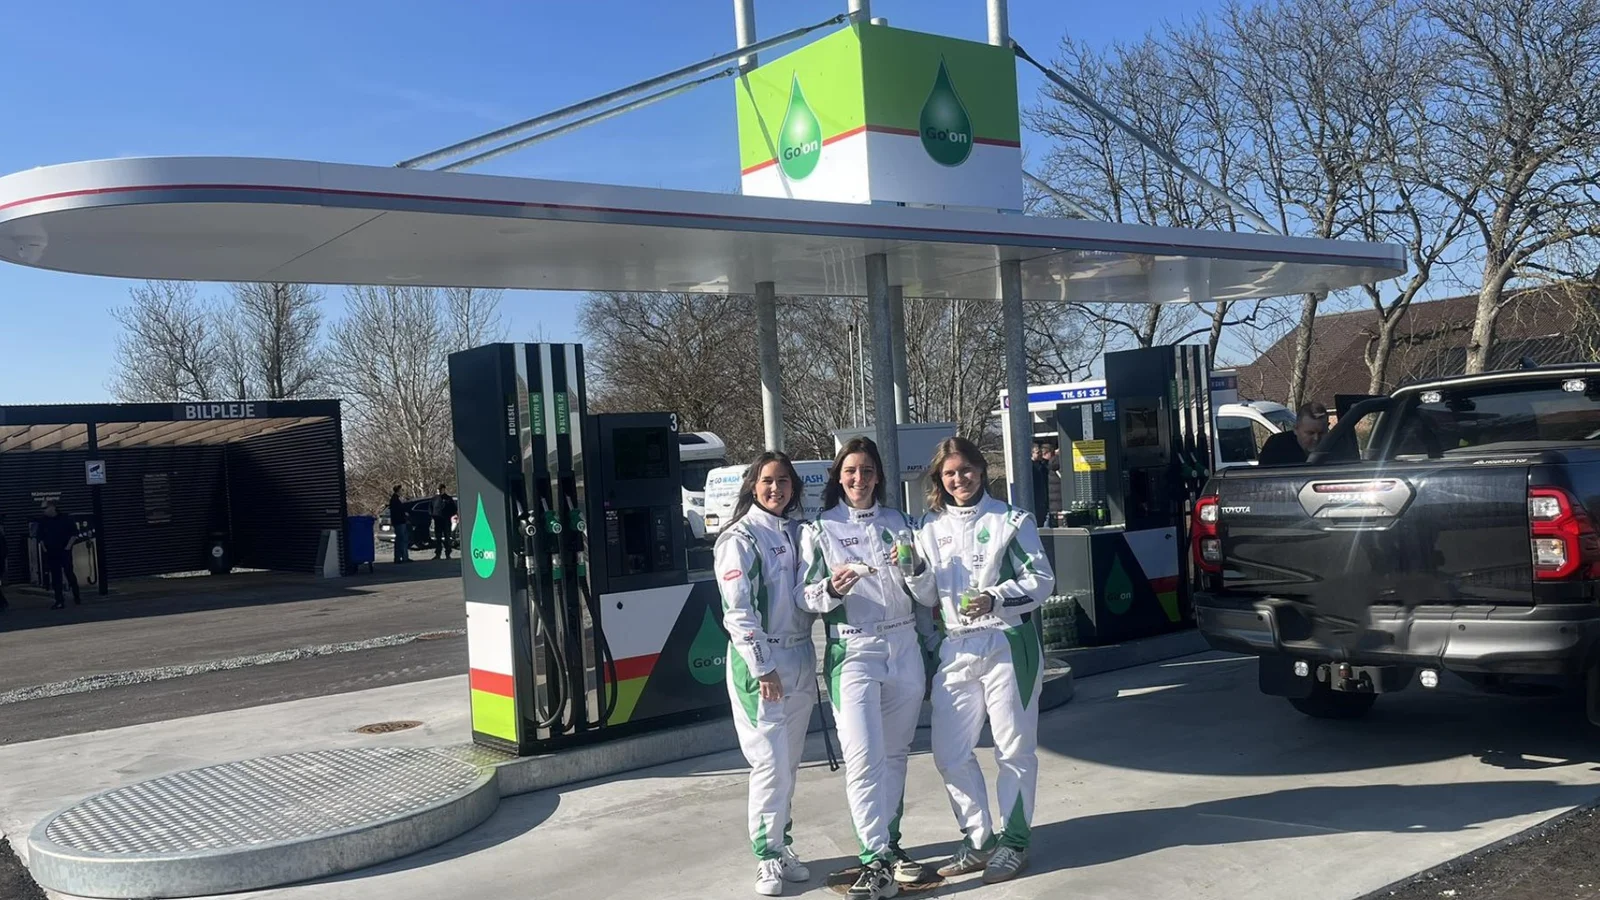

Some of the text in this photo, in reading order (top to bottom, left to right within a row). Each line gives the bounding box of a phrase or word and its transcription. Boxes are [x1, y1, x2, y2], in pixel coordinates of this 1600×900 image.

[926, 126, 968, 144] Go'on
[783, 138, 818, 160] Go'on
[1061, 391, 1075, 399] Tlf.
[1077, 390, 1087, 398] 51
[1089, 389, 1100, 397] 32
[185, 404, 256, 419] BILPLEJE
[507, 403, 516, 428] DIESEL
[669, 413, 678, 432] 3
[858, 511, 875, 519] HRX
[1221, 506, 1251, 514] TOYOTA
[839, 537, 859, 548] TSG
[938, 536, 952, 546] TSG
[473, 548, 495, 560] Go'on
[770, 545, 786, 555] TSG
